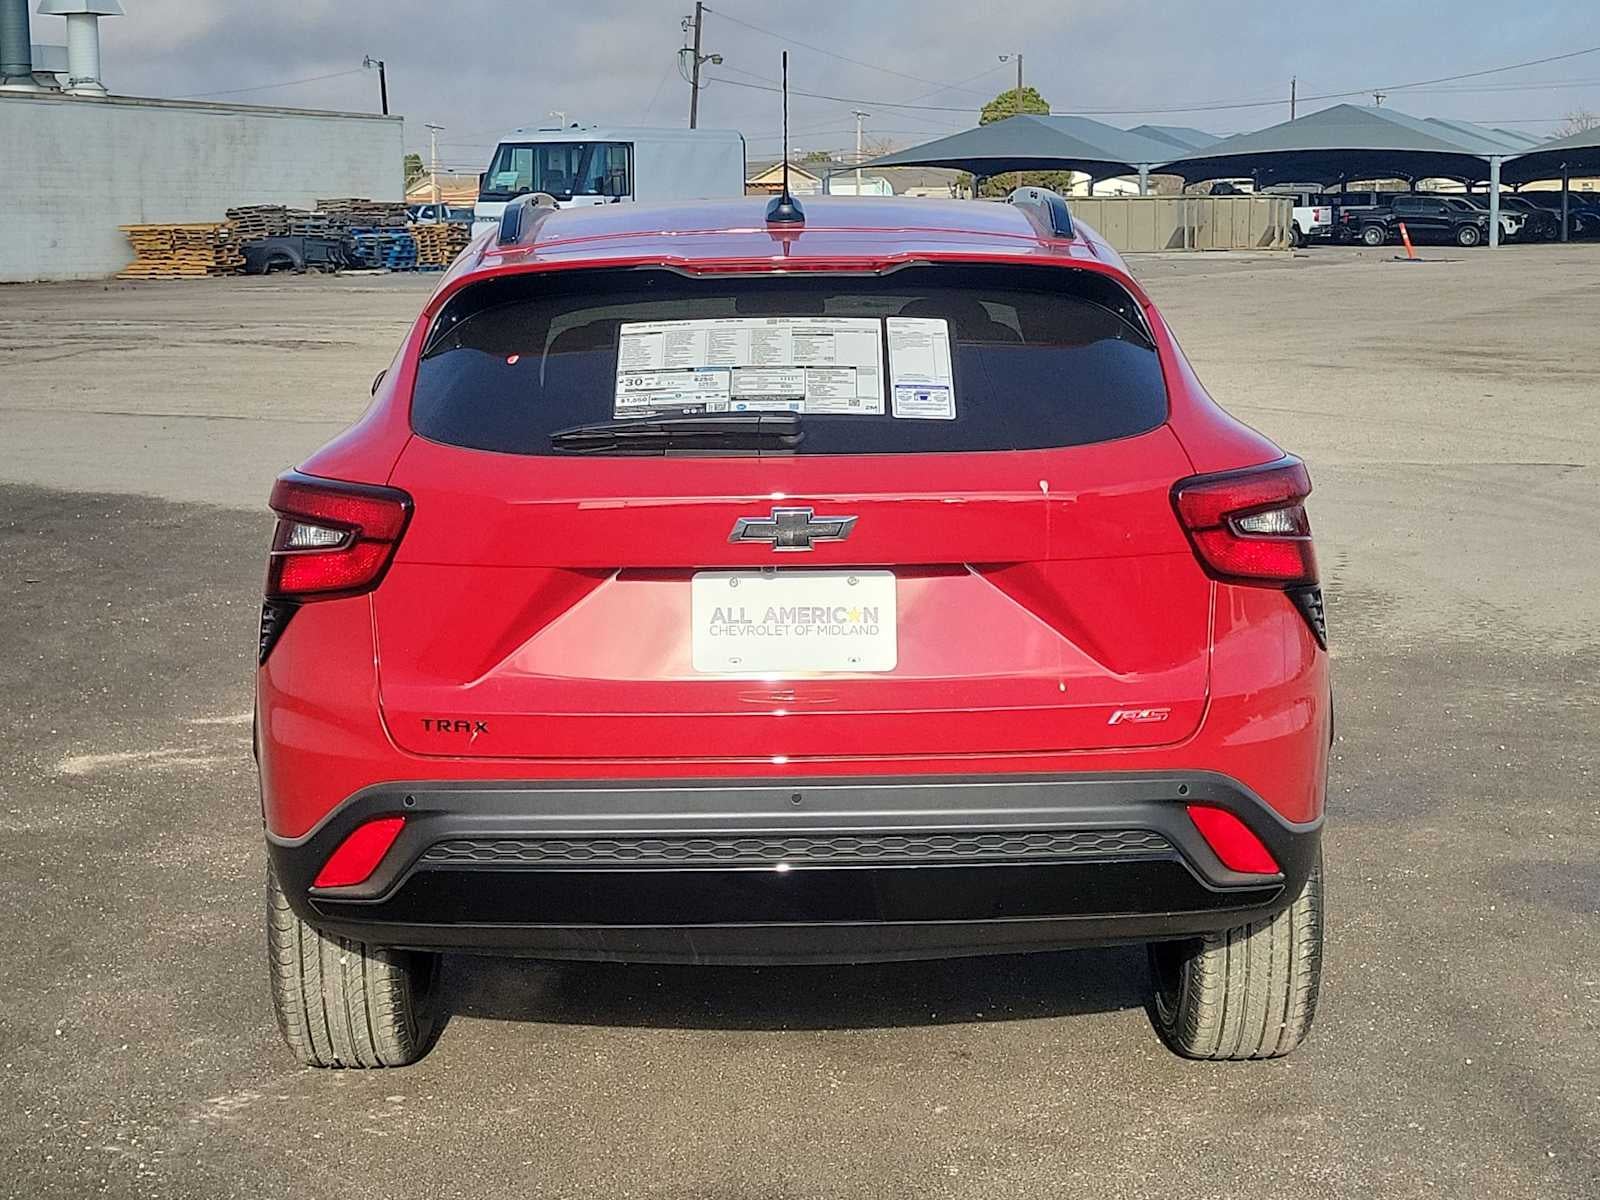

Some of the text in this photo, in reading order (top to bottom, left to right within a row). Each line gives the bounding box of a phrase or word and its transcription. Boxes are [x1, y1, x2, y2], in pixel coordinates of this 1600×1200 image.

[624, 378, 643, 387] 30
[710, 606, 752, 624] ALL
[709, 625, 880, 636] CHEVROLET OF MIDLAND
[1107, 707, 1171, 725] RS
[421, 719, 489, 733] TRAX
